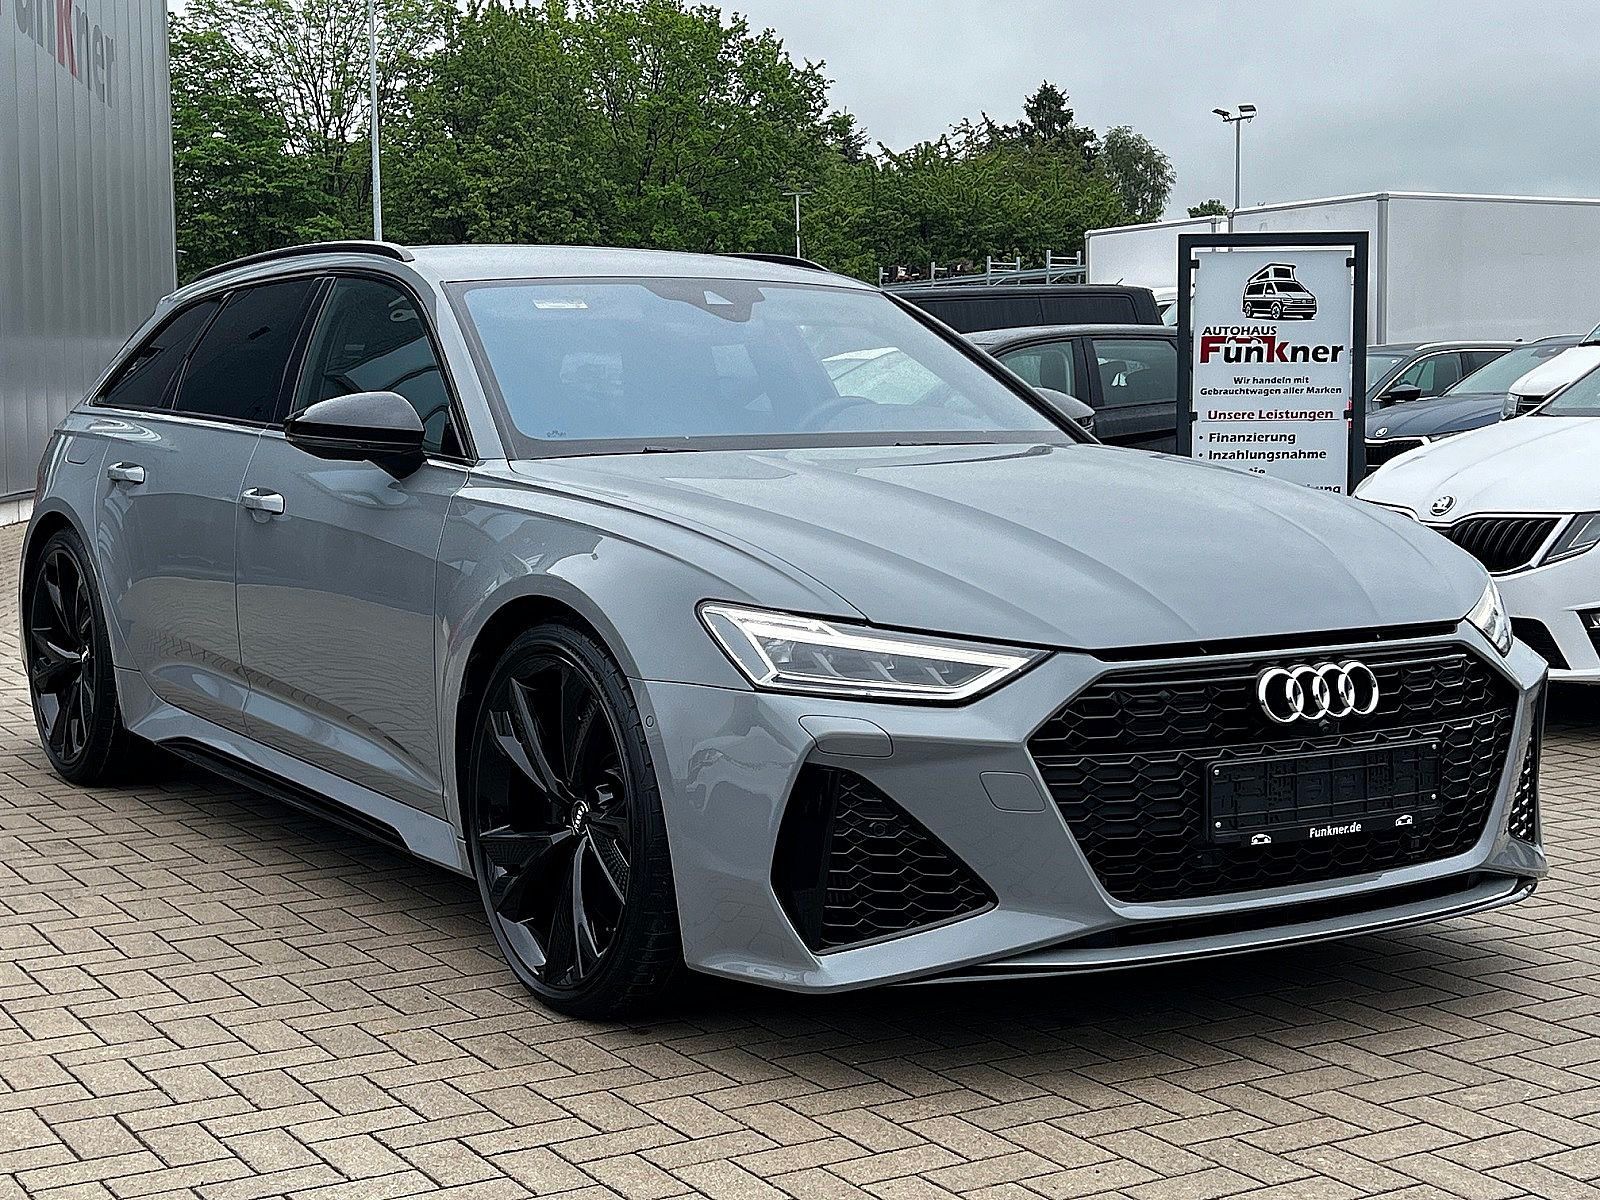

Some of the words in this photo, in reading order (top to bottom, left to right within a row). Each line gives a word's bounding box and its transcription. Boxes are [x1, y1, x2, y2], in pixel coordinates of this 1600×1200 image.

[0, 0, 116, 108] nkner
[1202, 325, 1278, 336] AUTOHAUS
[1200, 335, 1344, 364] Funkner
[1233, 376, 1251, 385] Wir
[1252, 376, 1292, 384] handeln
[1293, 376, 1310, 384] mit
[1200, 387, 1281, 397] Gebrauchtwagen
[1282, 387, 1305, 395] aller
[1306, 386, 1342, 394] Marken
[1207, 410, 1255, 420] Unsere
[1258, 409, 1334, 421] Leistungen
[1208, 432, 1297, 445] Finanzierung
[1208, 449, 1327, 463] Inzahlungsnahme
[1309, 821, 1362, 839] Funkner.de
